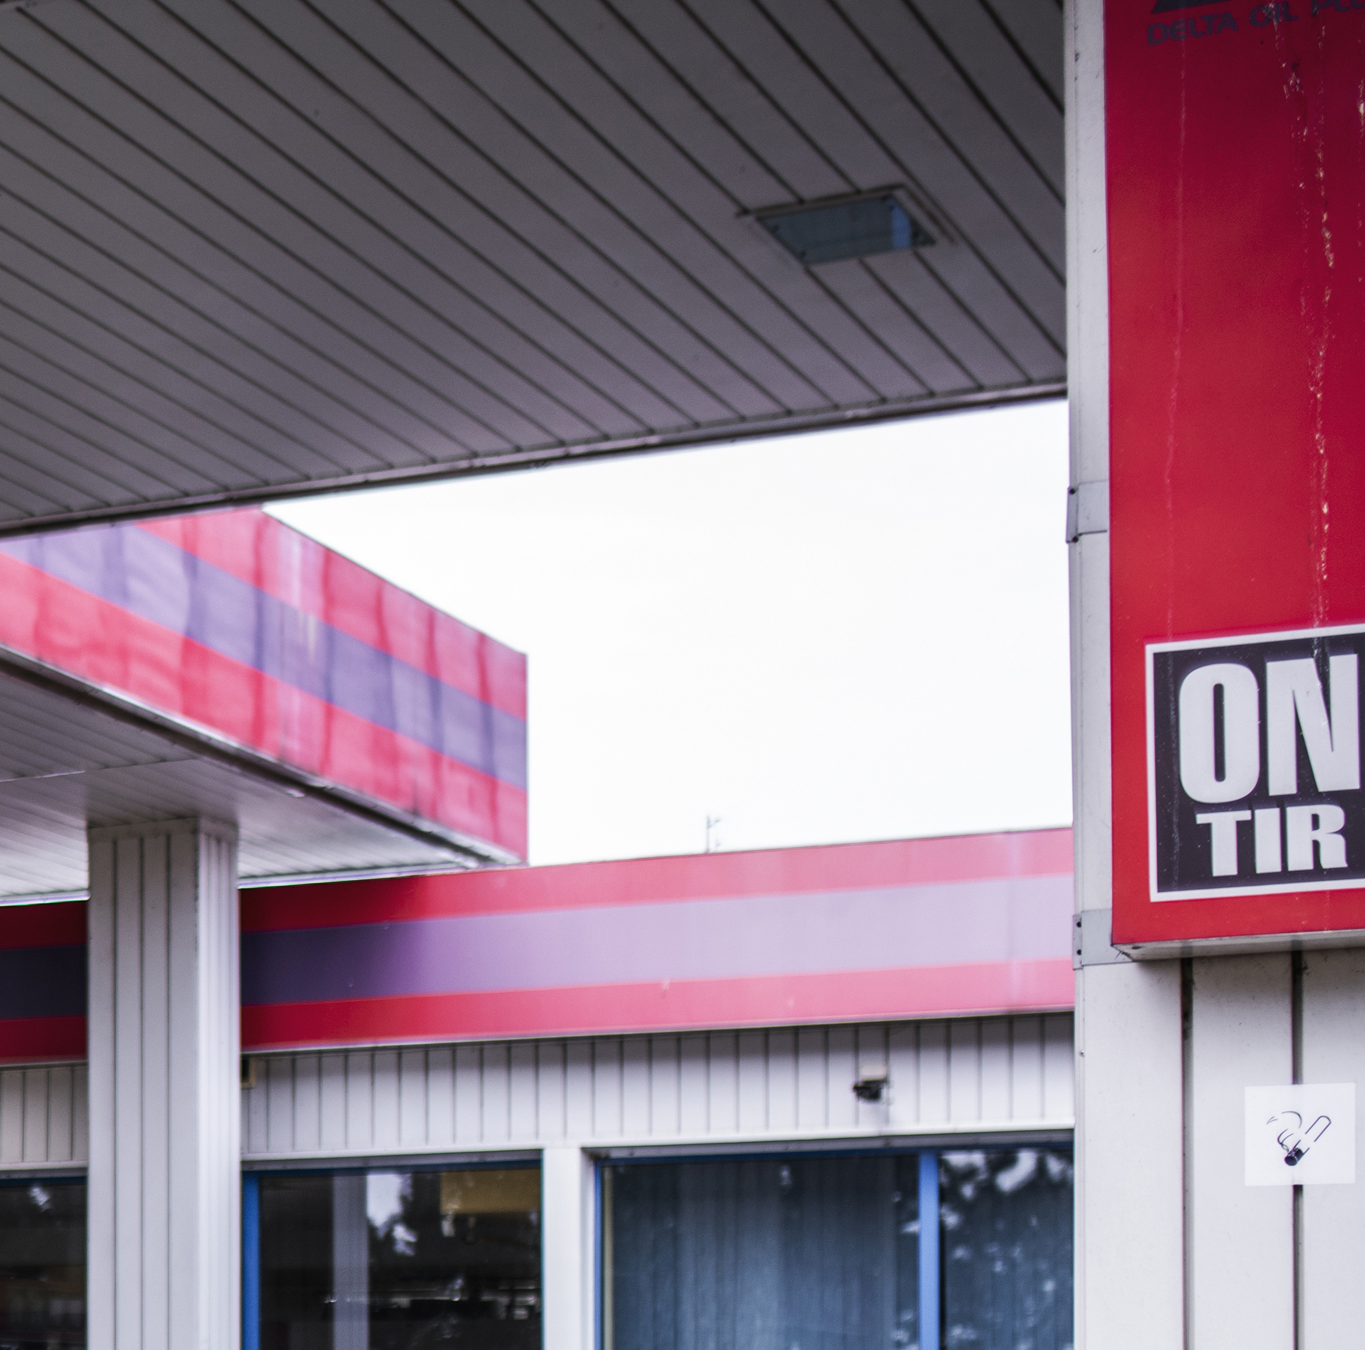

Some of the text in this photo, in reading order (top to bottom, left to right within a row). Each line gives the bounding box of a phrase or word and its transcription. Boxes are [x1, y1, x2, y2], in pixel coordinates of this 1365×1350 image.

[1147, 11, 1239, 45] DELTA
[1249, 2, 1299, 27] OIL
[1179, 654, 1361, 804] ON
[1196, 804, 1348, 878] TIR
